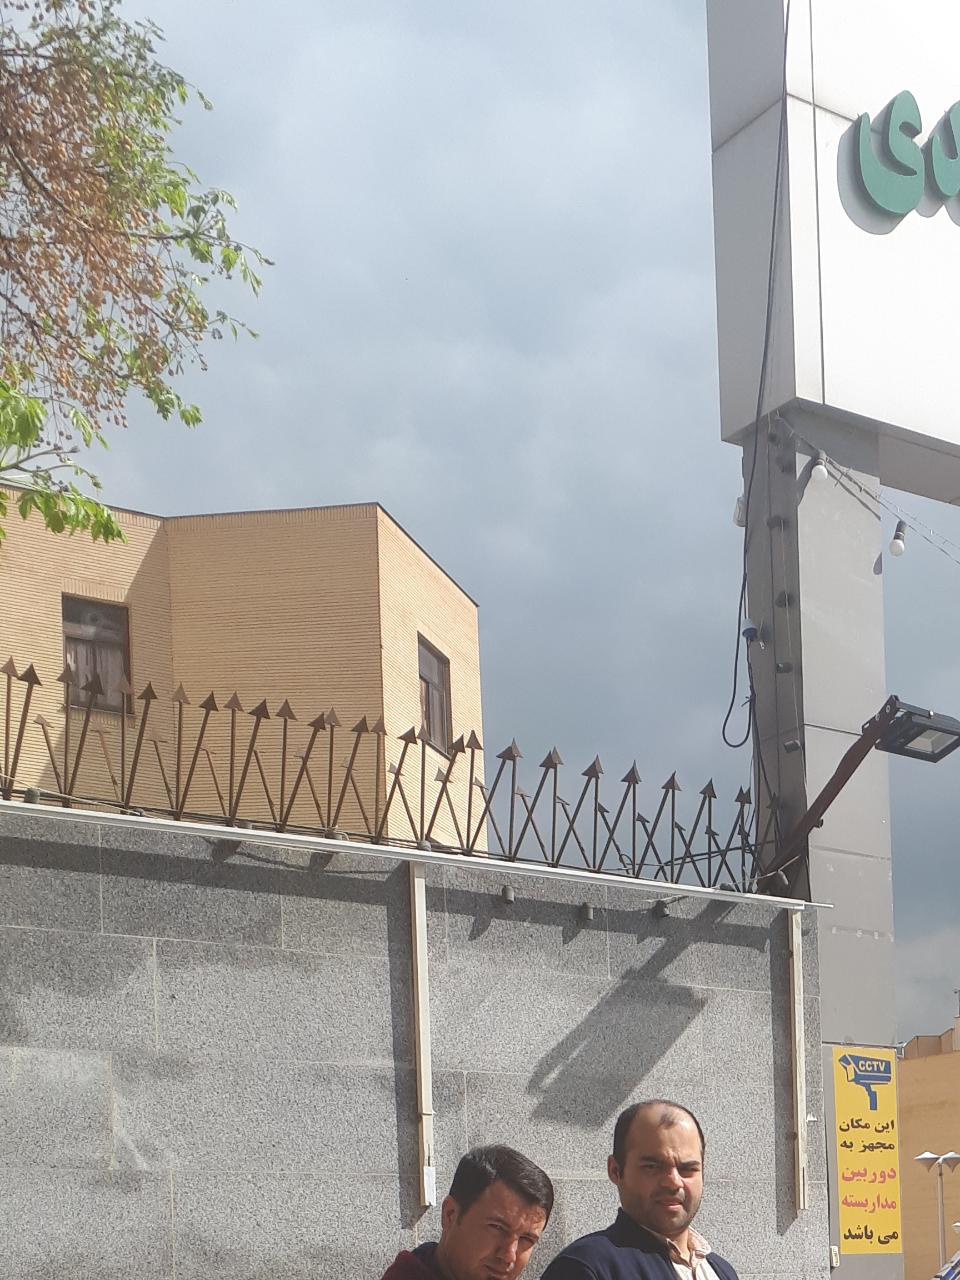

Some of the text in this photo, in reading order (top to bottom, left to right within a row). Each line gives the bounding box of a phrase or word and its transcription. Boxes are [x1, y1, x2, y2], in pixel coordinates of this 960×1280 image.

[858, 1060, 886, 1072] CCTV
[839, 1118, 895, 1133] این مکان
[840, 1138, 895, 1152] مجهز به
[841, 1166, 896, 1184] دوربین
[841, 1193, 896, 1213] مداربسته
[843, 1225, 898, 1245] می باشد
